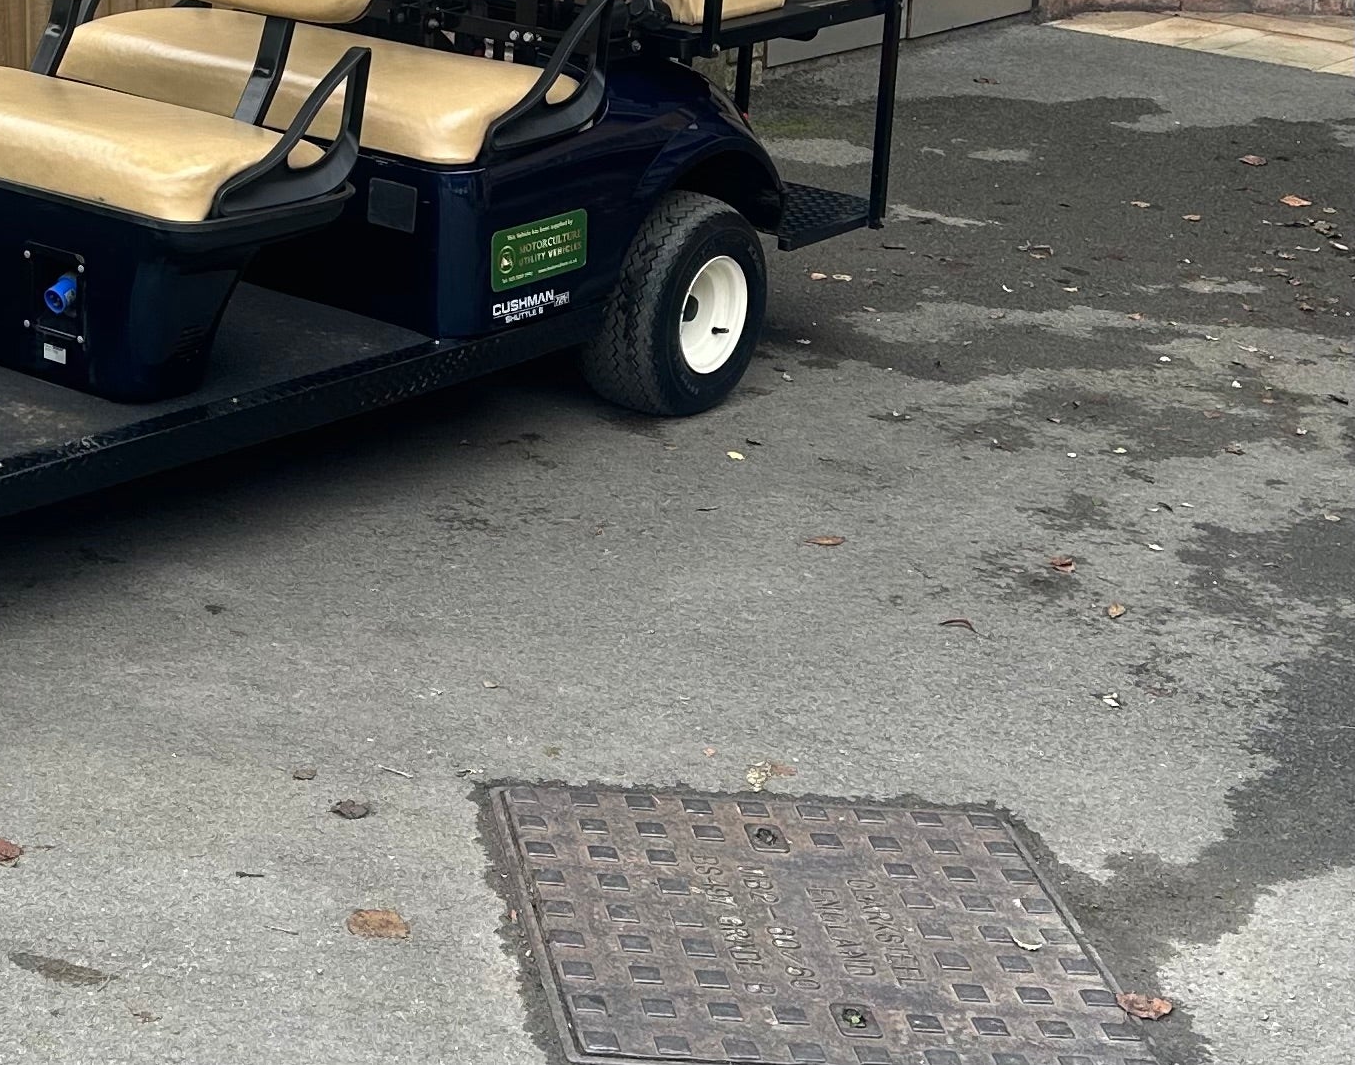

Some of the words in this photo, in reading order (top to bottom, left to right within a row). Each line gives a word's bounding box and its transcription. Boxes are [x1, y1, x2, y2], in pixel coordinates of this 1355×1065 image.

[548, 241, 582, 258] VEHICLES
[492, 289, 554, 316] CUSHMAN
[804, 886, 877, 976] ENGLAND
